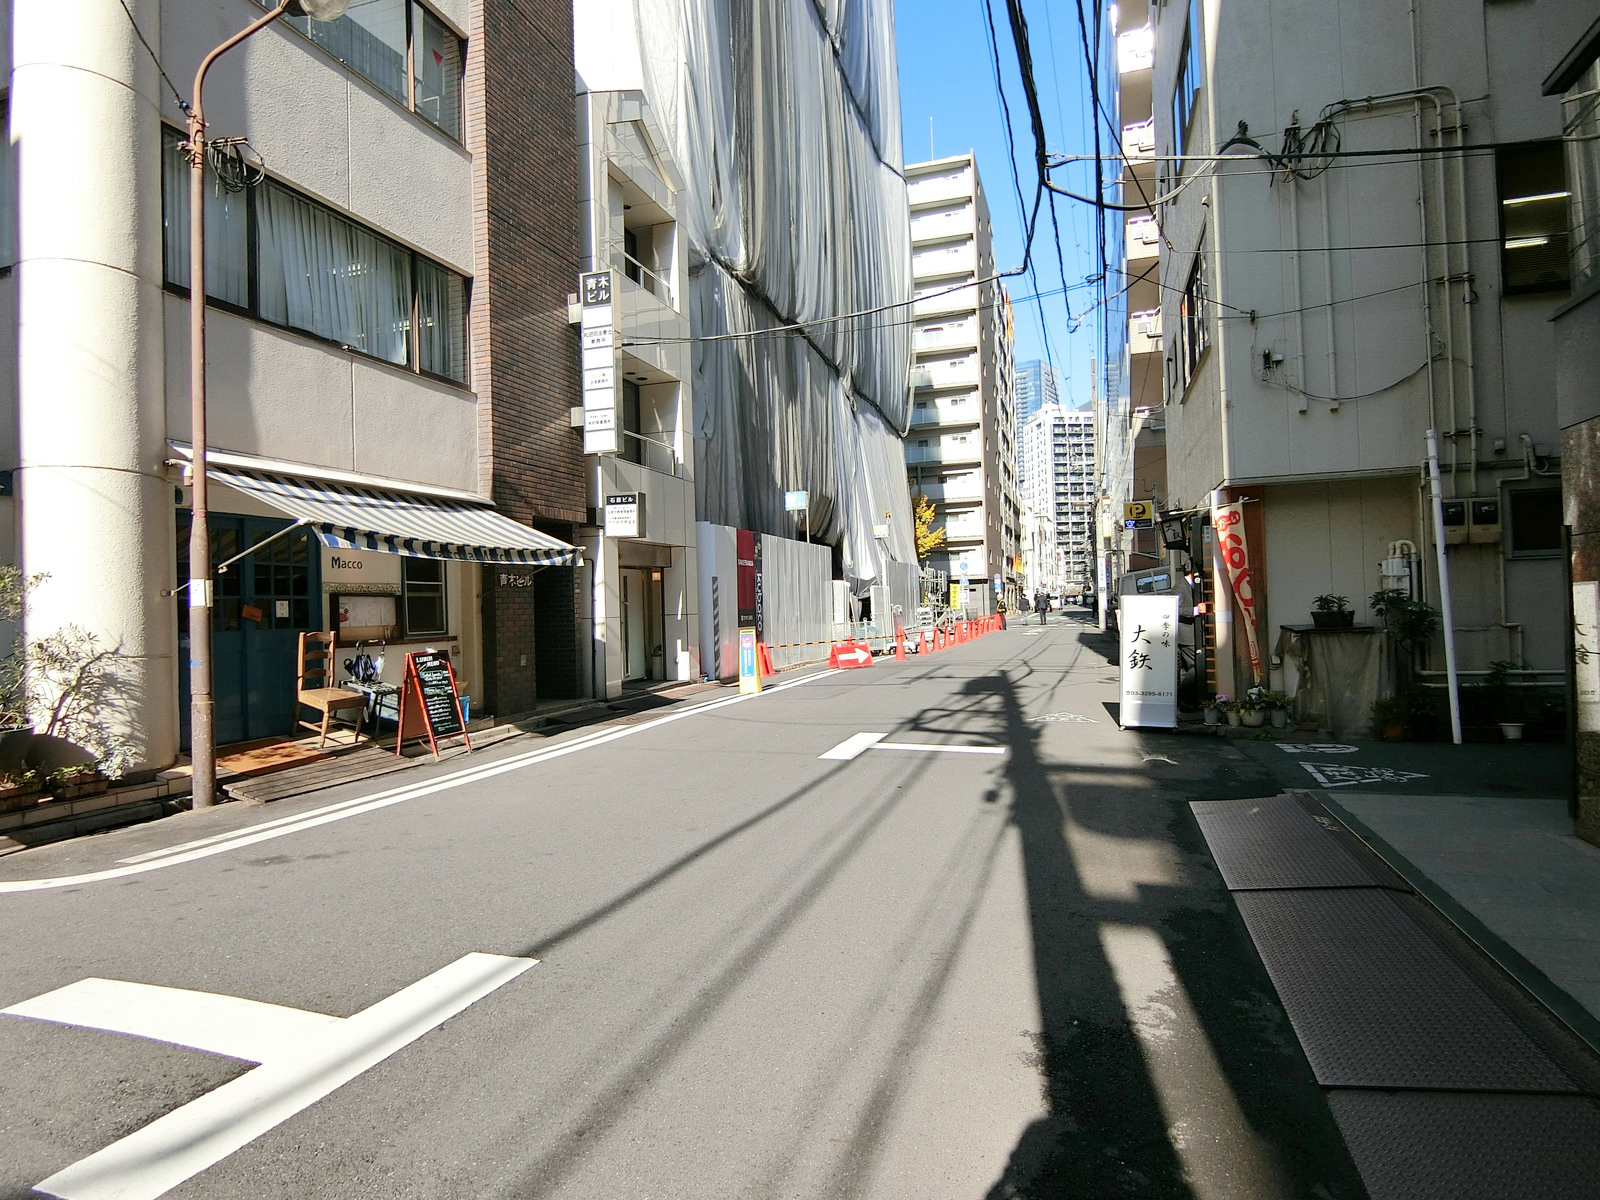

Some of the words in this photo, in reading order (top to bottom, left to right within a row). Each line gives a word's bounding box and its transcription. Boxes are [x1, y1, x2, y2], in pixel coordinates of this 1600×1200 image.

[586, 276, 609, 291] 青木
[587, 290, 610, 303] ビル
[331, 556, 363, 569] Macco
[499, 573, 533, 587] 青木ビル
[1161, 614, 1171, 648] 四季の味
